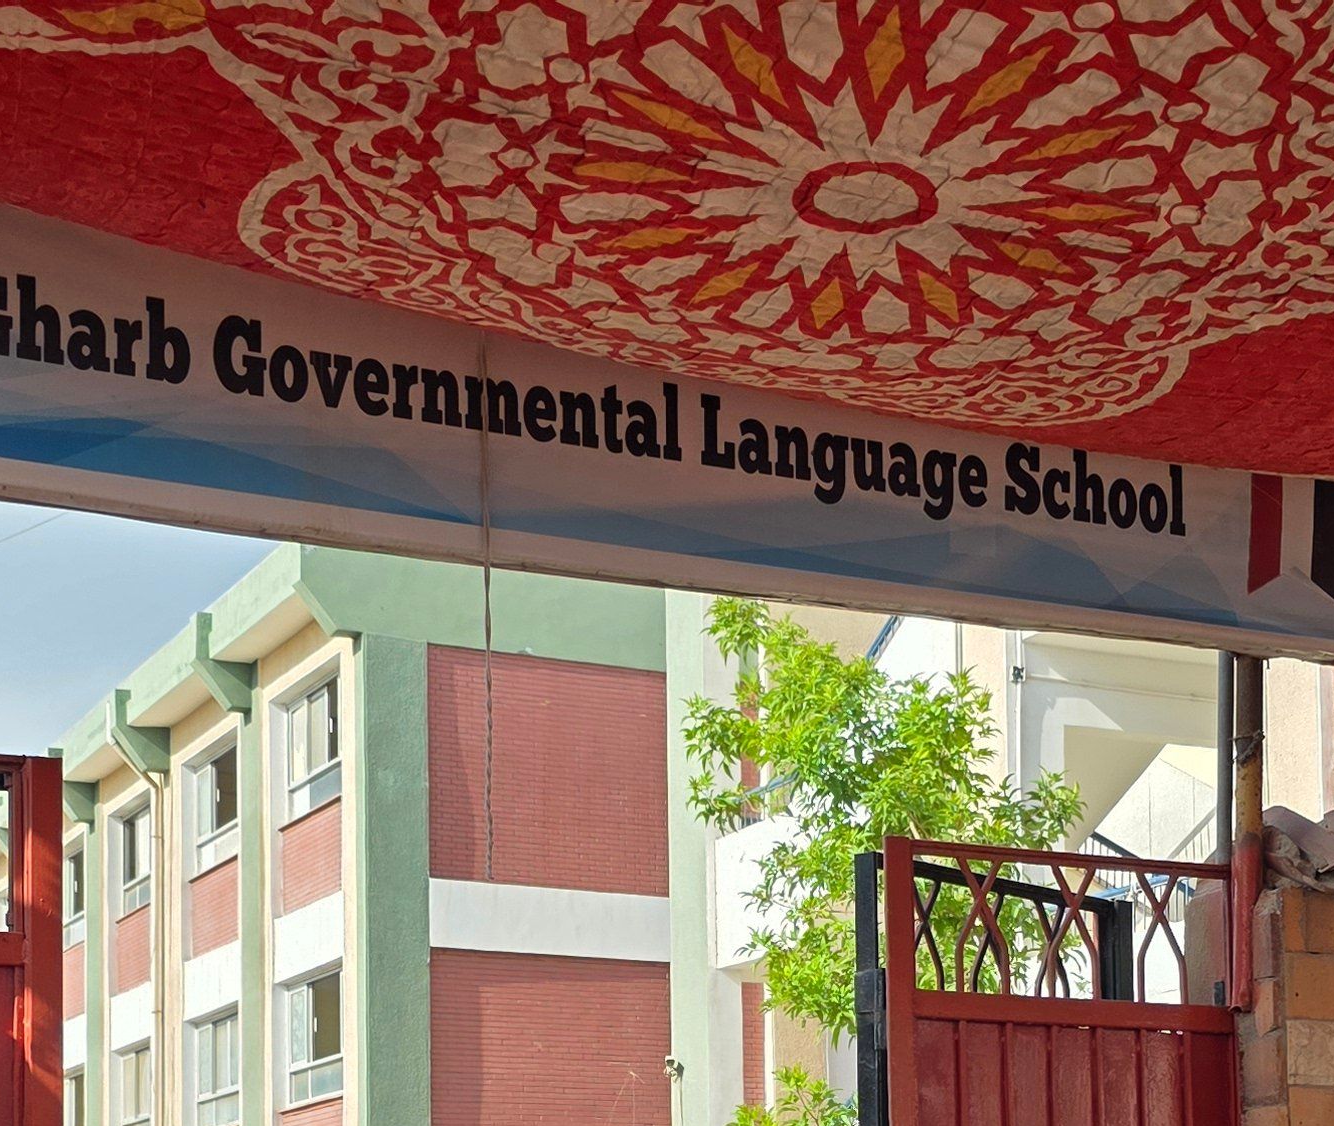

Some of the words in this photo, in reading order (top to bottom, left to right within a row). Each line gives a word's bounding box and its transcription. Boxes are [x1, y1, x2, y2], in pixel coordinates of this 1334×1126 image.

[212, 314, 683, 463] Governmental
[700, 393, 989, 521] Language
[1003, 442, 1187, 537] School
